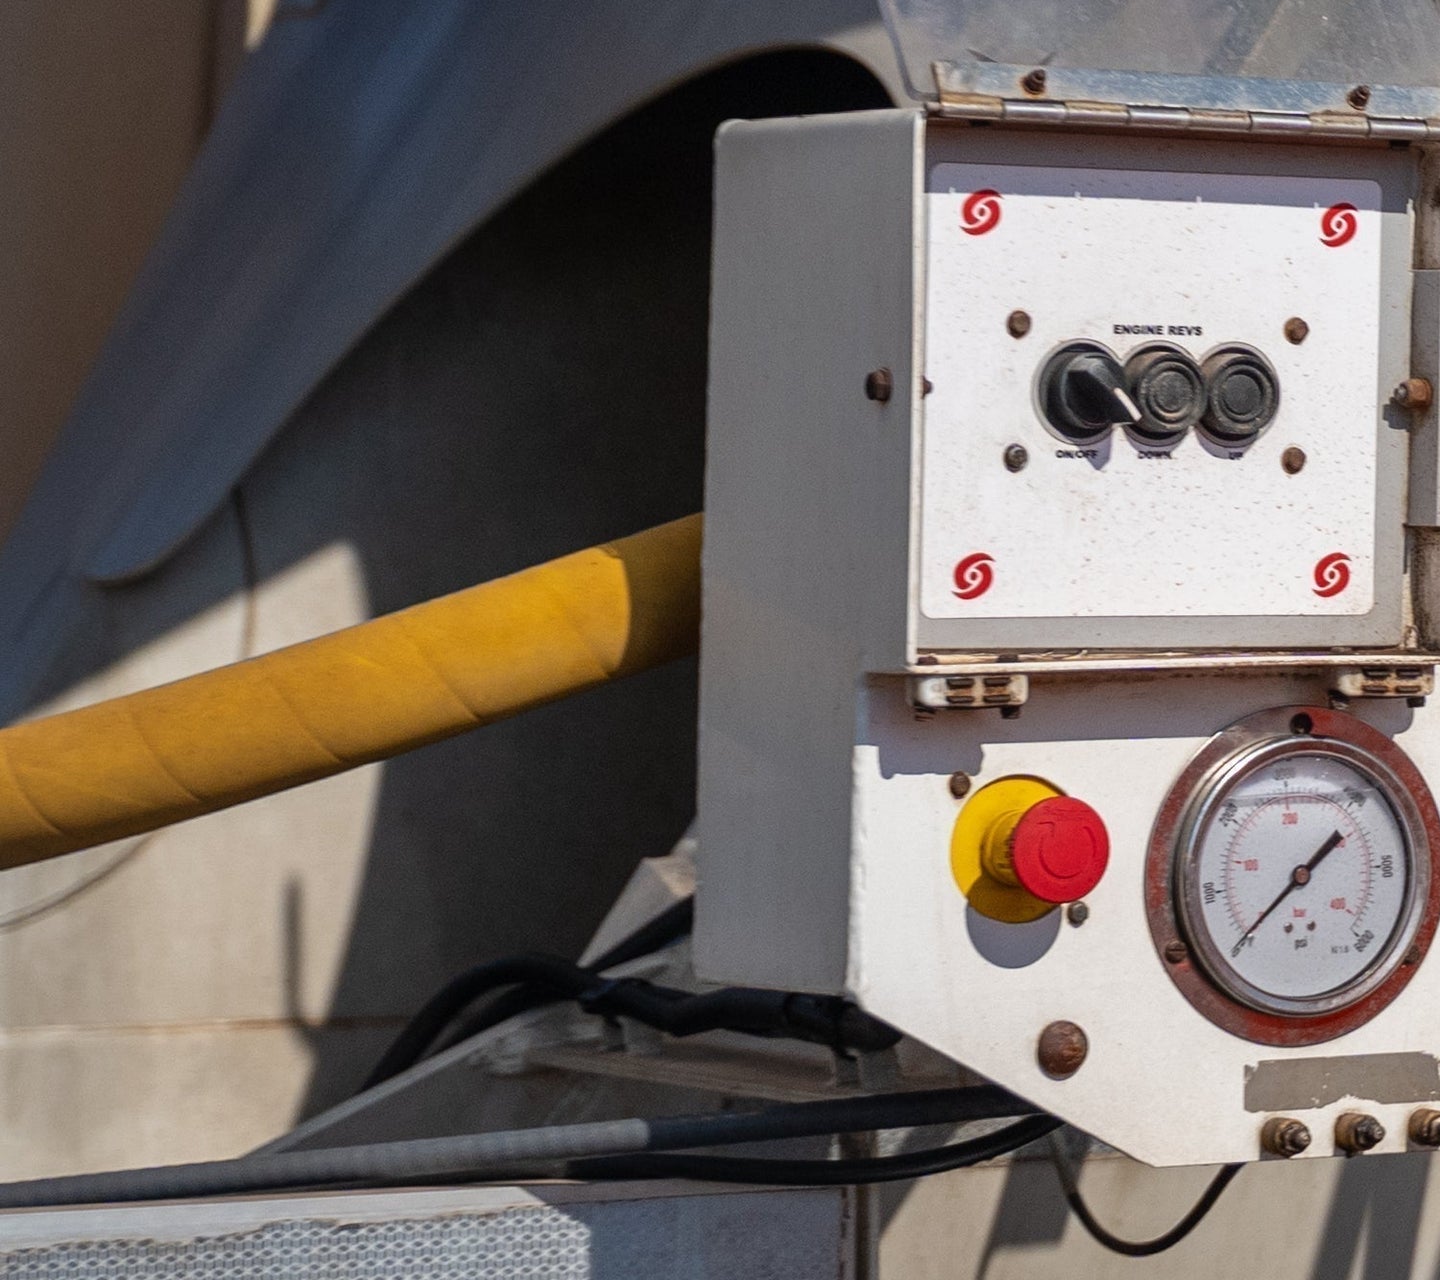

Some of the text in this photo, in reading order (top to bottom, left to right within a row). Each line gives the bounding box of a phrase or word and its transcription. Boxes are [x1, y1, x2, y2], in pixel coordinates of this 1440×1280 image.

[1113, 324, 1203, 337] ENGINE REVS
[1055, 449, 1099, 459] ON/OFF
[1137, 450, 1173, 460] DOWN
[1228, 451, 1244, 461] UP
[1380, 854, 1394, 878] 5000
[1203, 882, 1215, 905] 1000
